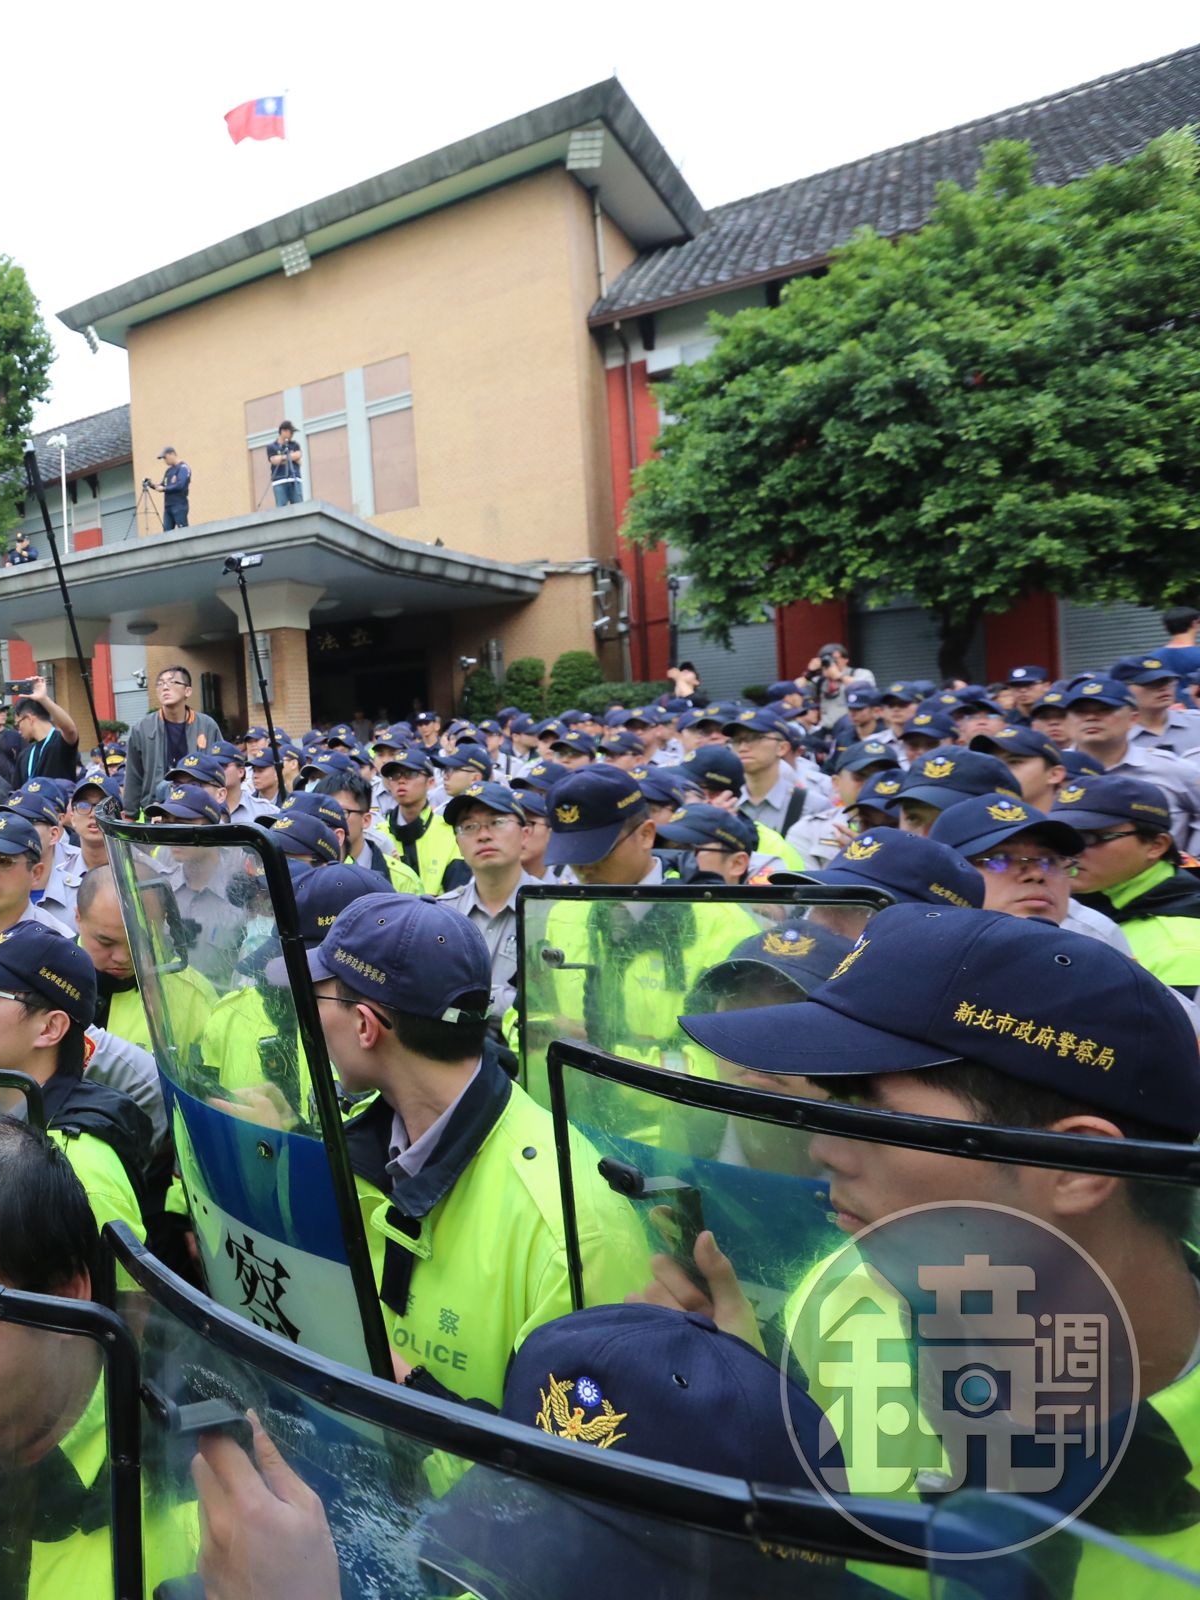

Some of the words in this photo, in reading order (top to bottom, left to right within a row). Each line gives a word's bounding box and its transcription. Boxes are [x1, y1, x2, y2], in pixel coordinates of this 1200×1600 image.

[334, 946, 387, 985] 新北市政府警察局
[953, 1000, 1116, 1072] 新北市政府警察局
[392, 1323, 468, 1372] OLICE
